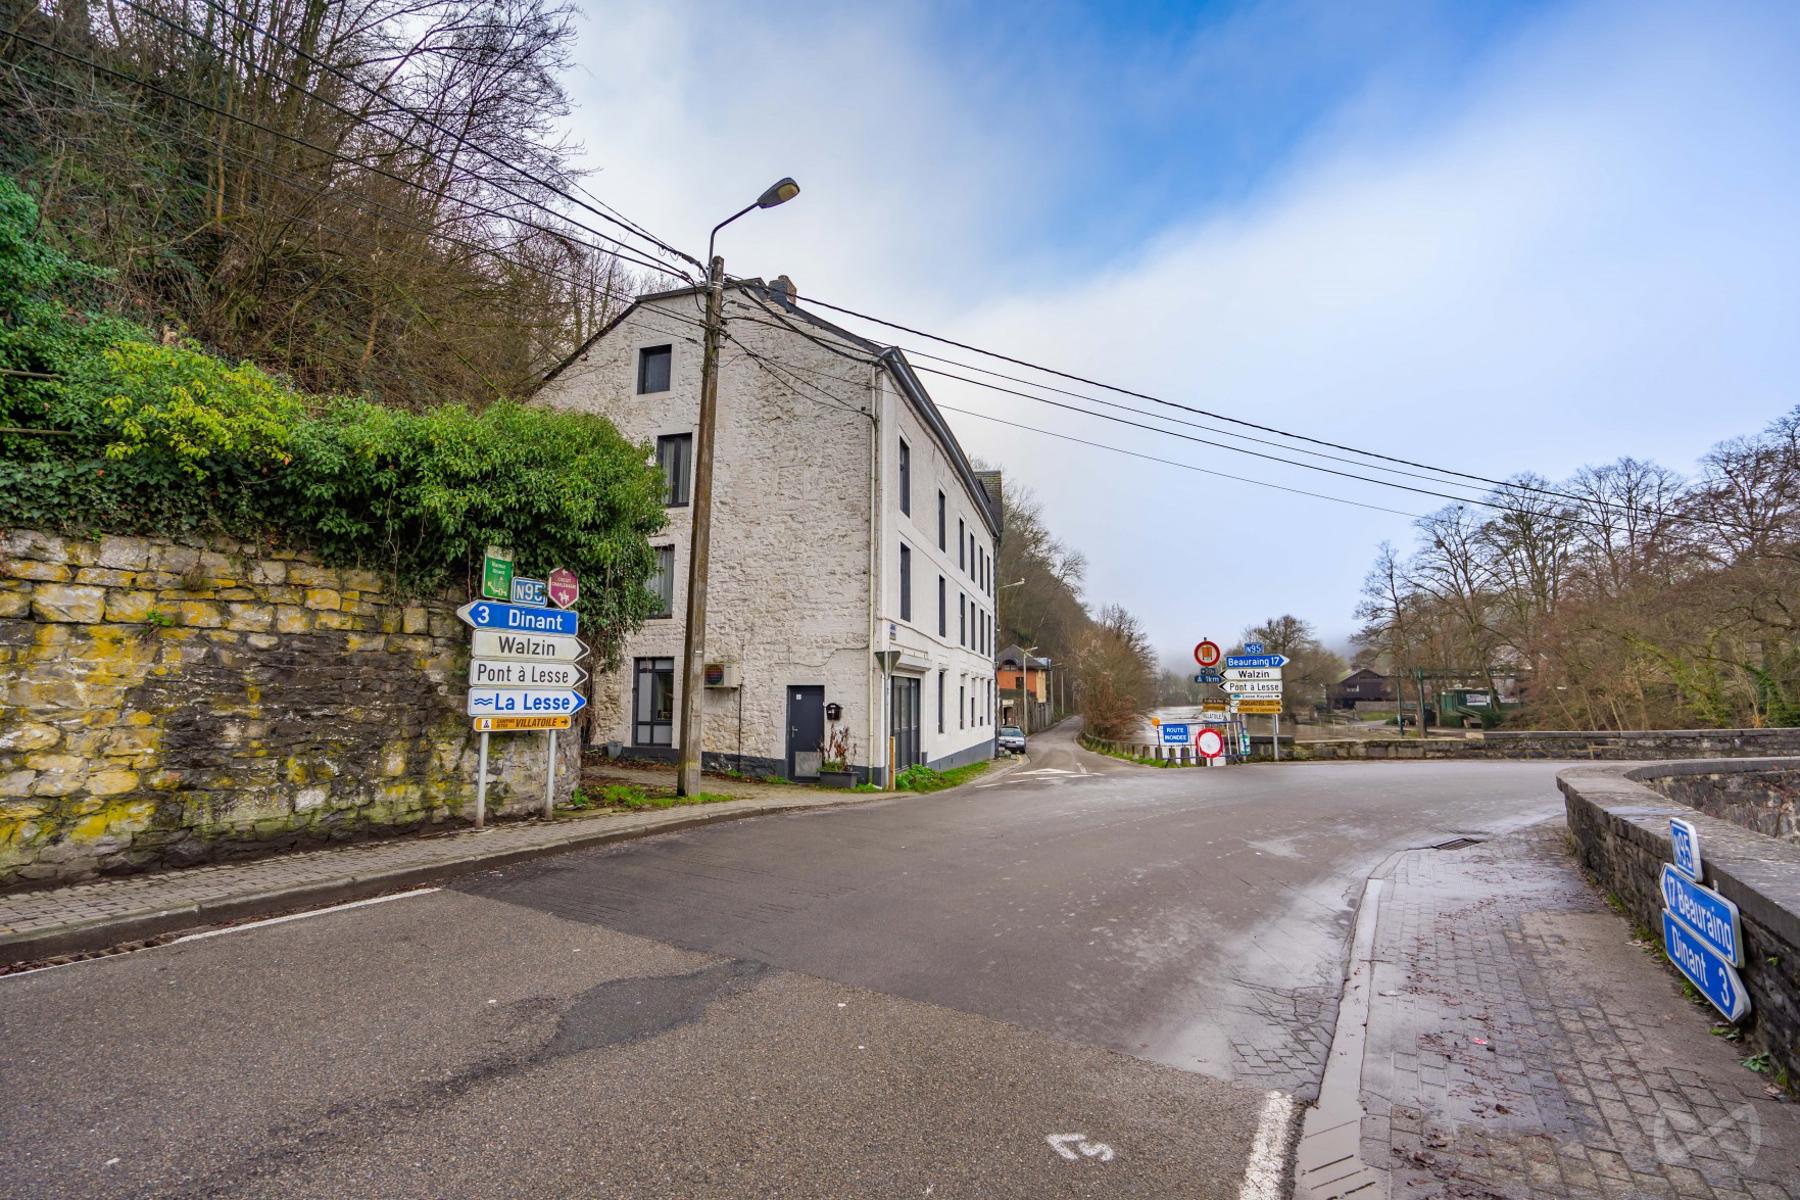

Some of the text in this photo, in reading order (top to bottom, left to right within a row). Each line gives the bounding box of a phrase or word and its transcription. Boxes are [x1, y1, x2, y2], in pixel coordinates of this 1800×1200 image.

[516, 583, 544, 602] N95
[477, 605, 563, 631] 3 Dinant
[498, 635, 556, 657] Walzin
[1228, 656, 1280, 668] Beauraing 17
[477, 663, 569, 683] Pont à Lesse
[1238, 670, 1270, 679] Walzin
[1229, 682, 1279, 691] Pont à Lesse
[494, 693, 570, 711] La Lesse
[1666, 874, 1734, 960] 17 Beauraing
[1671, 925, 1730, 1007] Dinant 3
